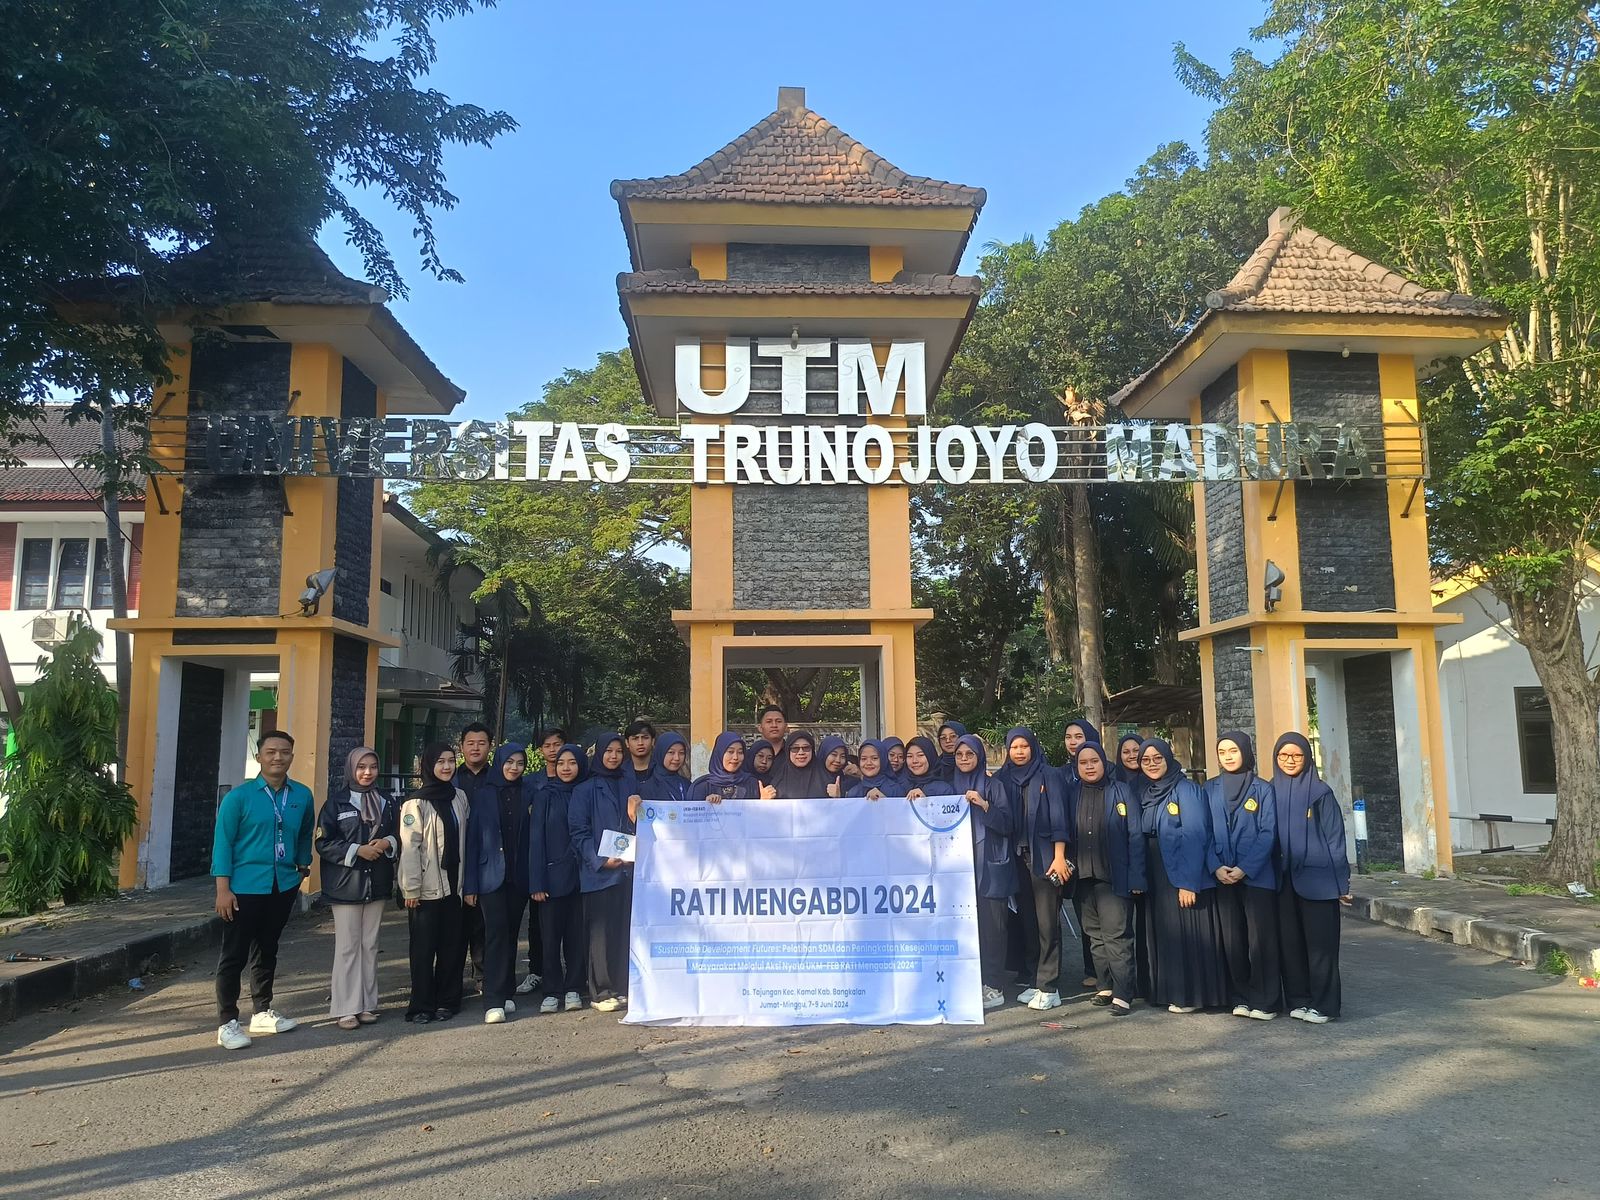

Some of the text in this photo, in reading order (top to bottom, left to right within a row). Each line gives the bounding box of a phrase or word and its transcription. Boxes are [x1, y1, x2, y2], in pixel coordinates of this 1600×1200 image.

[675, 338, 926, 416] UTM
[204, 414, 1375, 485] UNIVERSITAS TRUNOJOYO MADURA
[941, 804, 960, 814] 2024
[670, 885, 937, 916] RATI MENGABDI 2024
[782, 943, 818, 953] Pelatihan
[818, 943, 835, 953] SDM
[836, 943, 850, 953] dan
[851, 943, 899, 954] Peningkatan
[691, 961, 736, 973] Masyarakat
[765, 961, 782, 971] Aksi
[859, 960, 896, 972] Mengabdi
[753, 988, 782, 998] Tajungan
[796, 988, 817, 996] Kamal
[832, 988, 866, 998] Bangkalan
